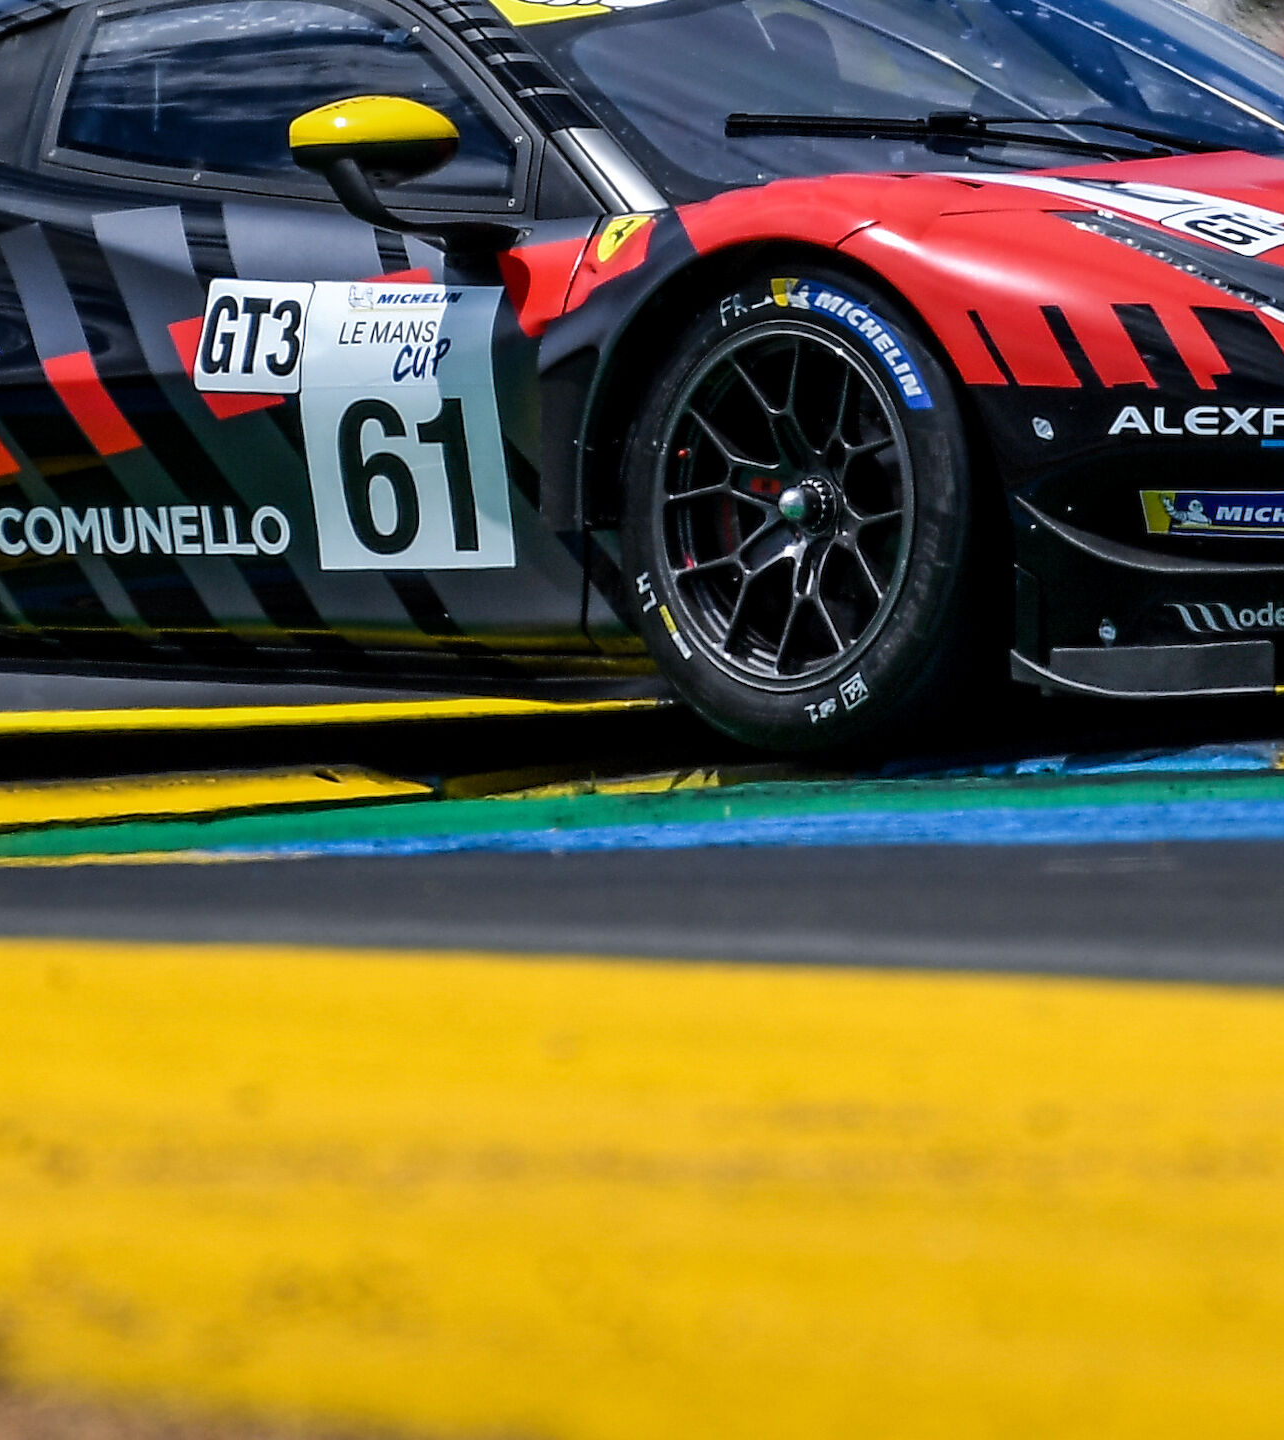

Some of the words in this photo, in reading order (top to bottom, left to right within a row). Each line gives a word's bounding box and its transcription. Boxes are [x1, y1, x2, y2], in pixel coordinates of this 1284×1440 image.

[376, 291, 463, 304] MICHELIN
[200, 295, 302, 377] GT3
[338, 321, 367, 345] LE
[369, 320, 437, 344] MANS
[393, 338, 452, 382] CUP
[814, 291, 922, 398] MICHELIN
[338, 397, 479, 555] 61
